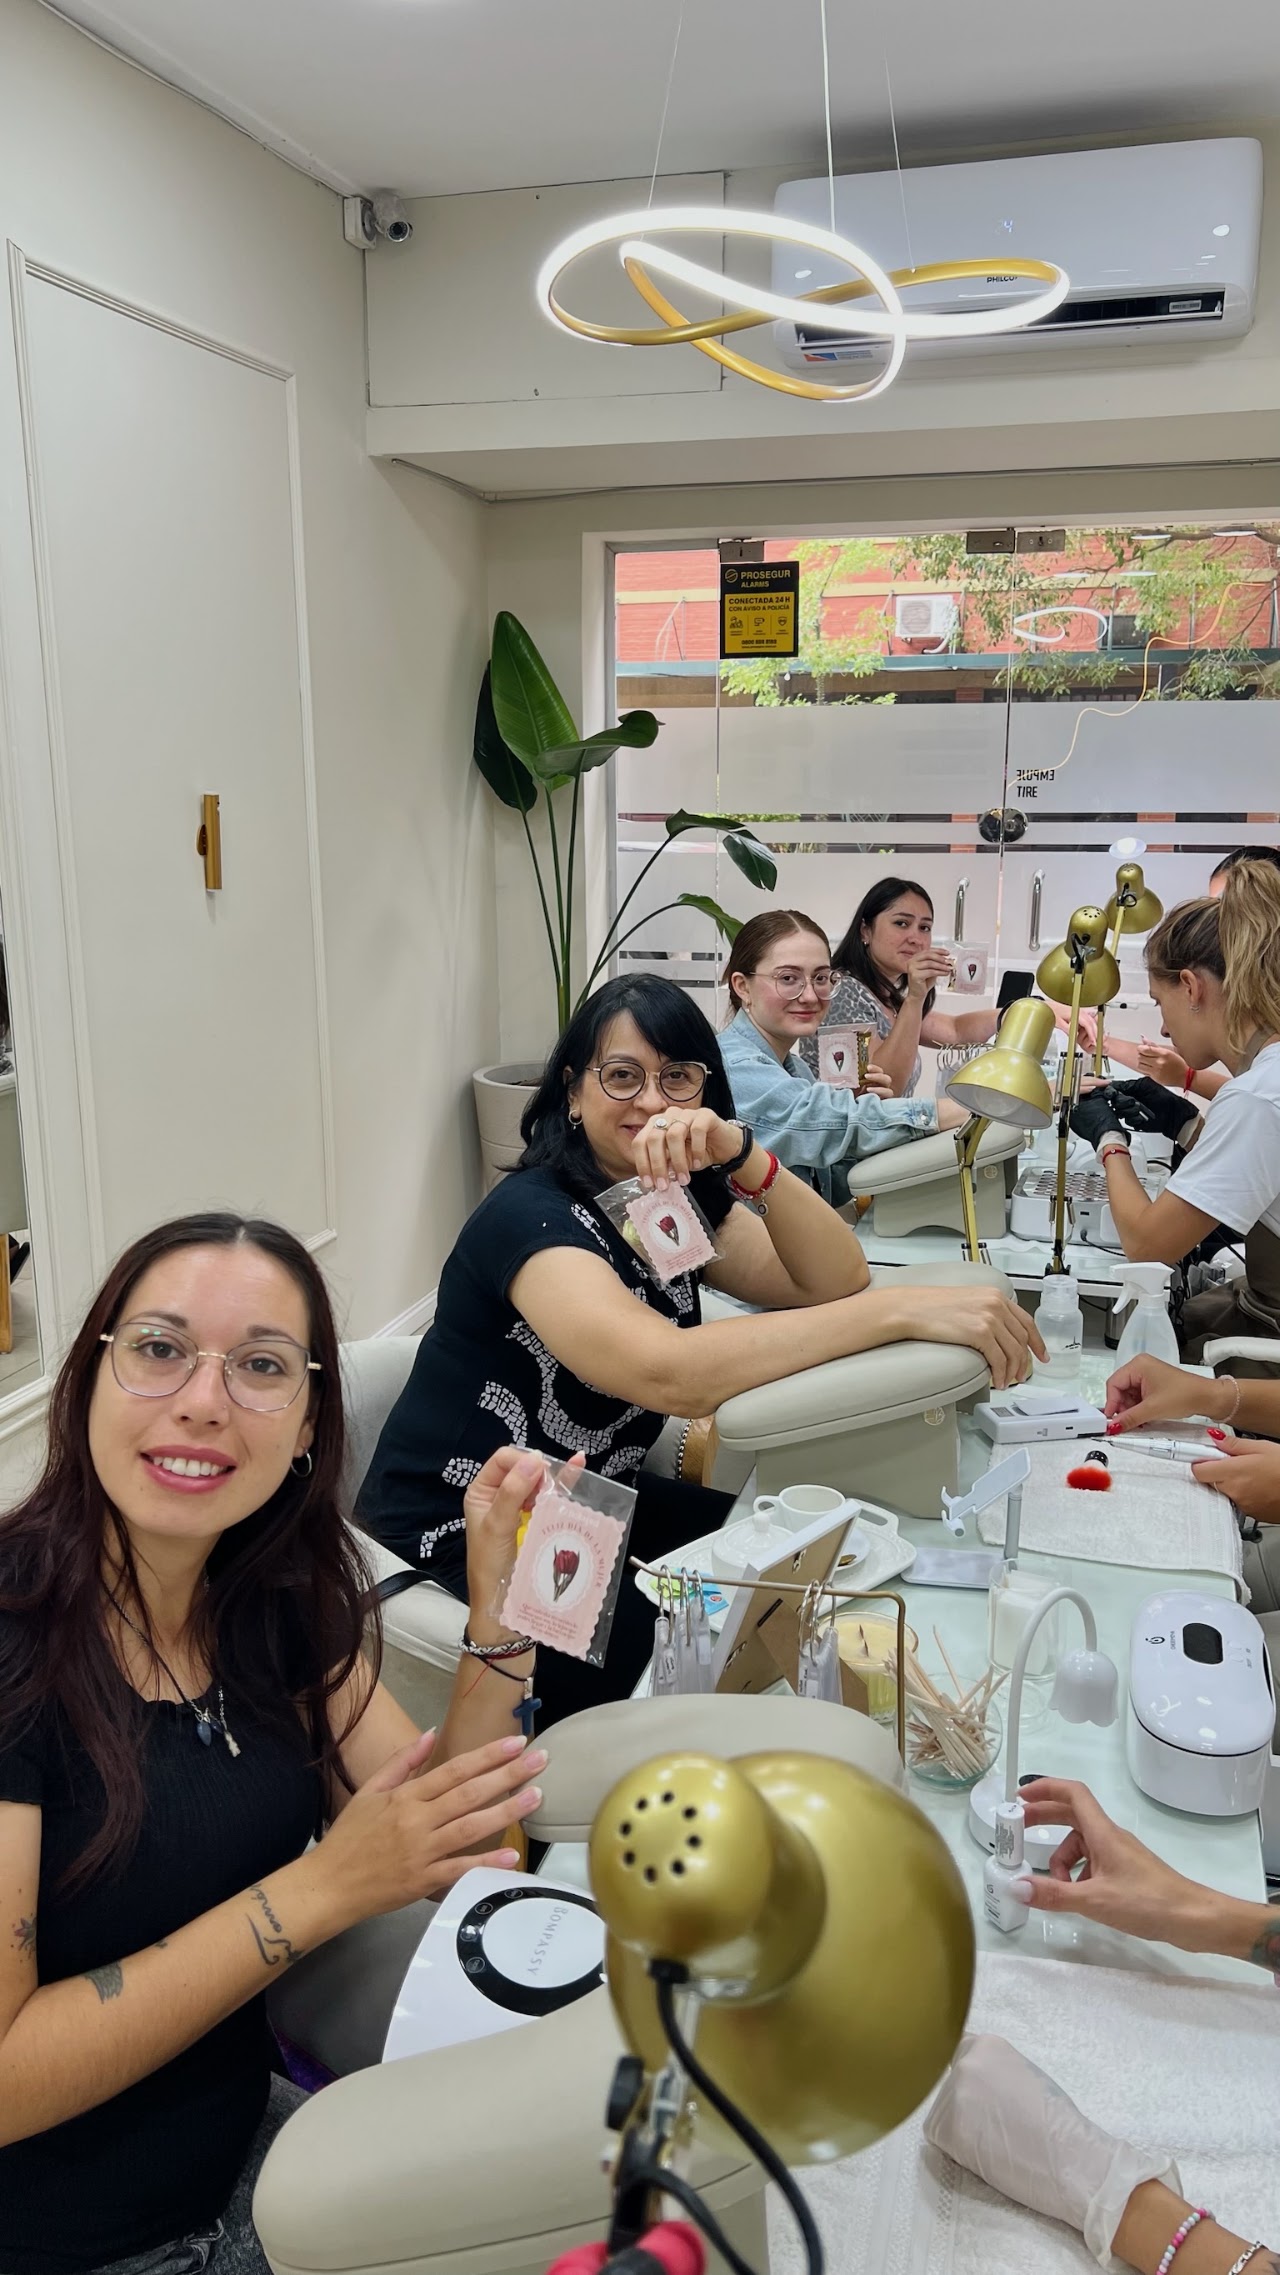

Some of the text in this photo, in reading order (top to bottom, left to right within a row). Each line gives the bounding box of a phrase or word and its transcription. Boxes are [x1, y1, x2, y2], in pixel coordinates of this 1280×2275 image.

[741, 569, 790, 579] PROSEGUR
[1017, 786, 1038, 798] TIRE
[542, 1521, 565, 1536] FELIZ
[593, 1543, 602, 1556] LA
[595, 1557, 605, 1588] MUJER
[528, 1906, 568, 1975] BOMPASSY
